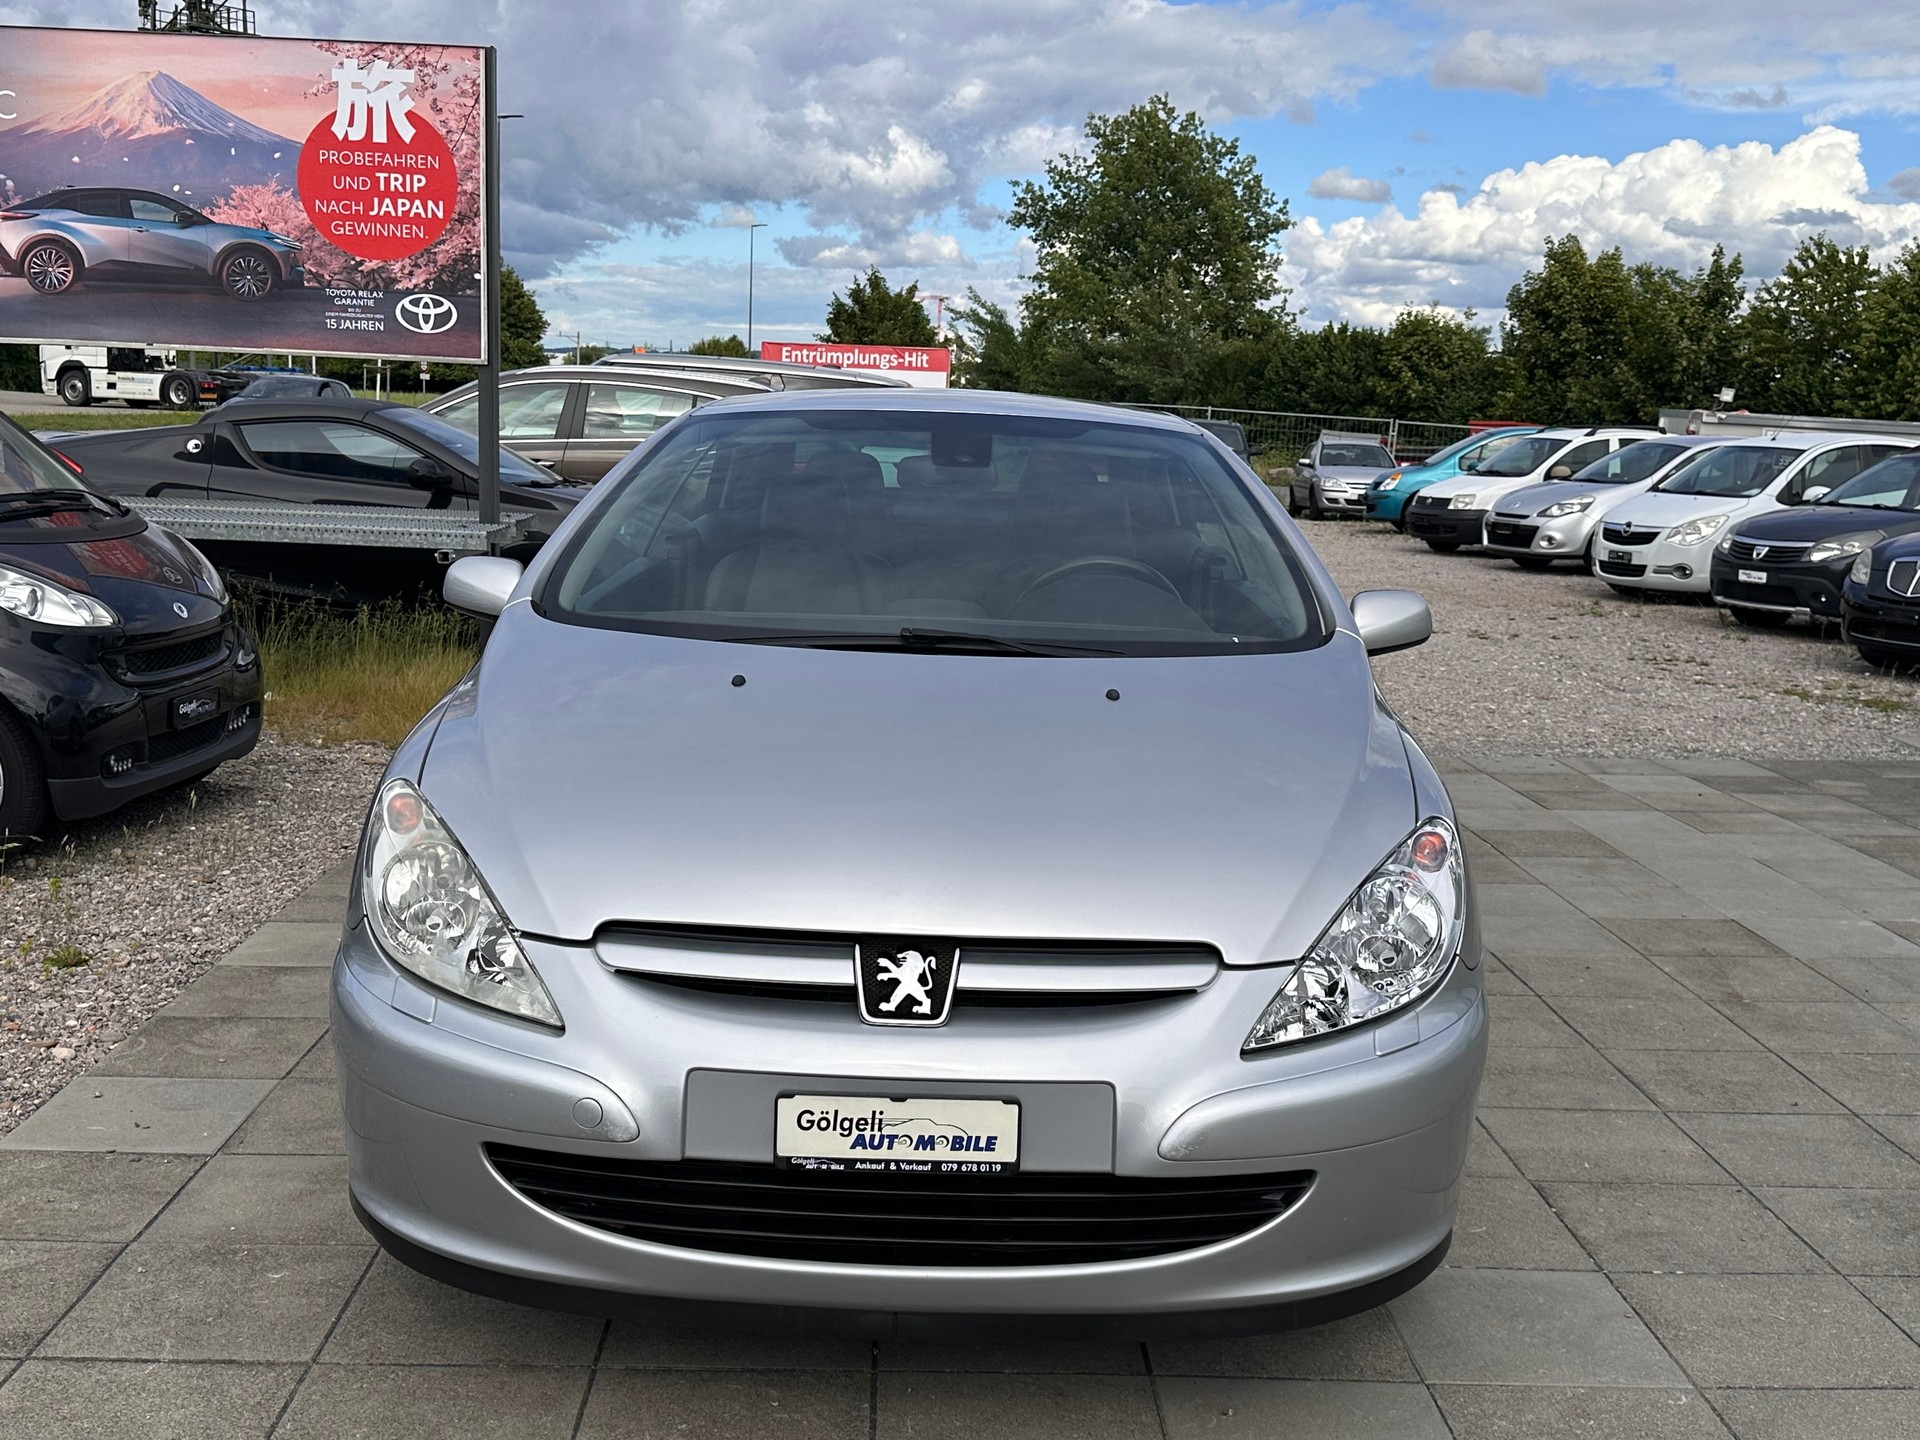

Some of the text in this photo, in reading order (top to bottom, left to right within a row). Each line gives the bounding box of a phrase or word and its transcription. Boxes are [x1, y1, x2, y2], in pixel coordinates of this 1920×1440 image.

[330, 58, 417, 145] 旅
[319, 150, 440, 169] PROBEFAHREN
[333, 172, 427, 193] UND TRIP
[315, 197, 444, 219] NACH JAPAN
[331, 221, 429, 239] GEWINNEN.
[325, 289, 384, 298] TOYOTA RELAX
[334, 297, 375, 307] GARANTIE
[325, 318, 384, 331] 15 JAHREN
[781, 346, 929, 369] Entrümplungs-Hit
[796, 1109, 884, 1137] Gölgeli
[855, 1161, 885, 1170] Ankauf
[889, 1162, 897, 1170] &
[900, 1162, 932, 1172] Verkauf
[941, 1163, 958, 1172] 079
[961, 1163, 978, 1172] 678
